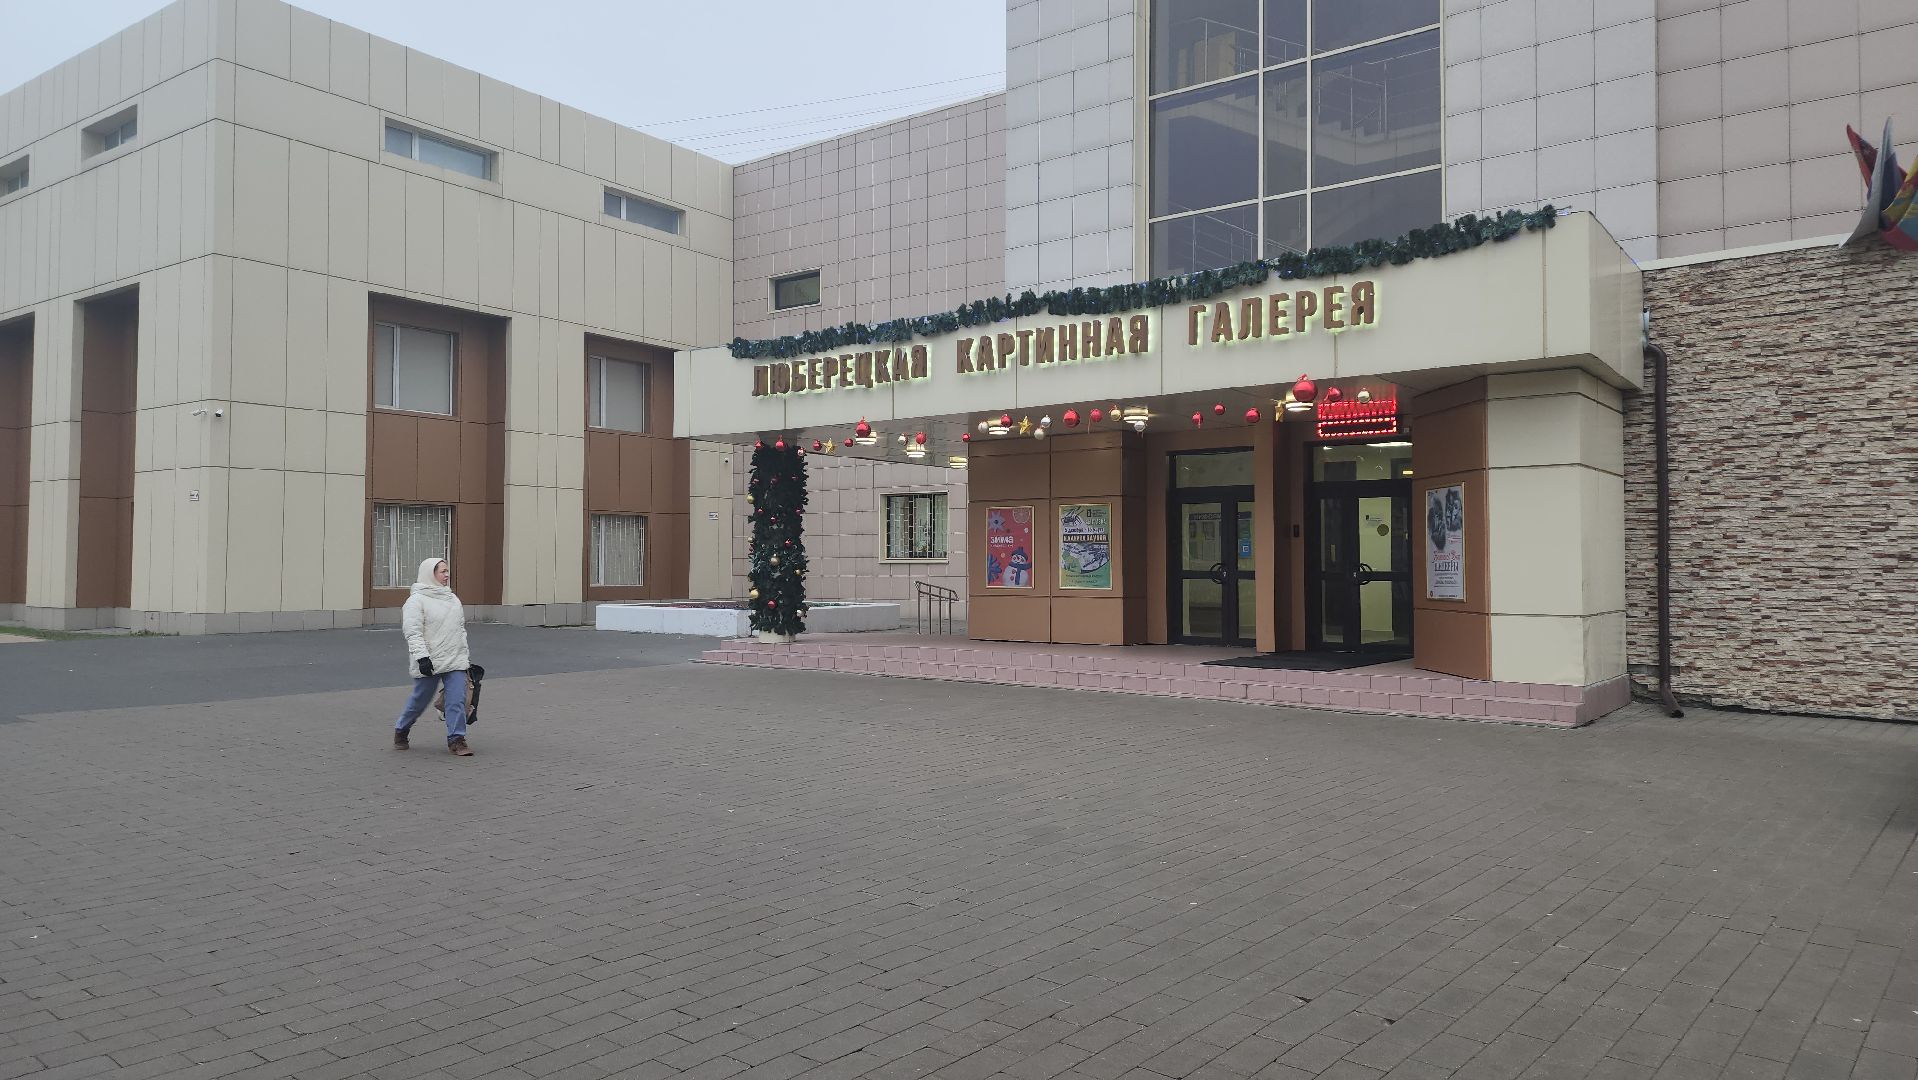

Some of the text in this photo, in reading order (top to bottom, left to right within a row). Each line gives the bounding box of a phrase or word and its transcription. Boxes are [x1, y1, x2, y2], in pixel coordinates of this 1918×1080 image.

[752, 280, 1375, 397] ЛЮБЕРЕЦКАЯ КАРТИННАЯ ГАЛЕРЕЯ
